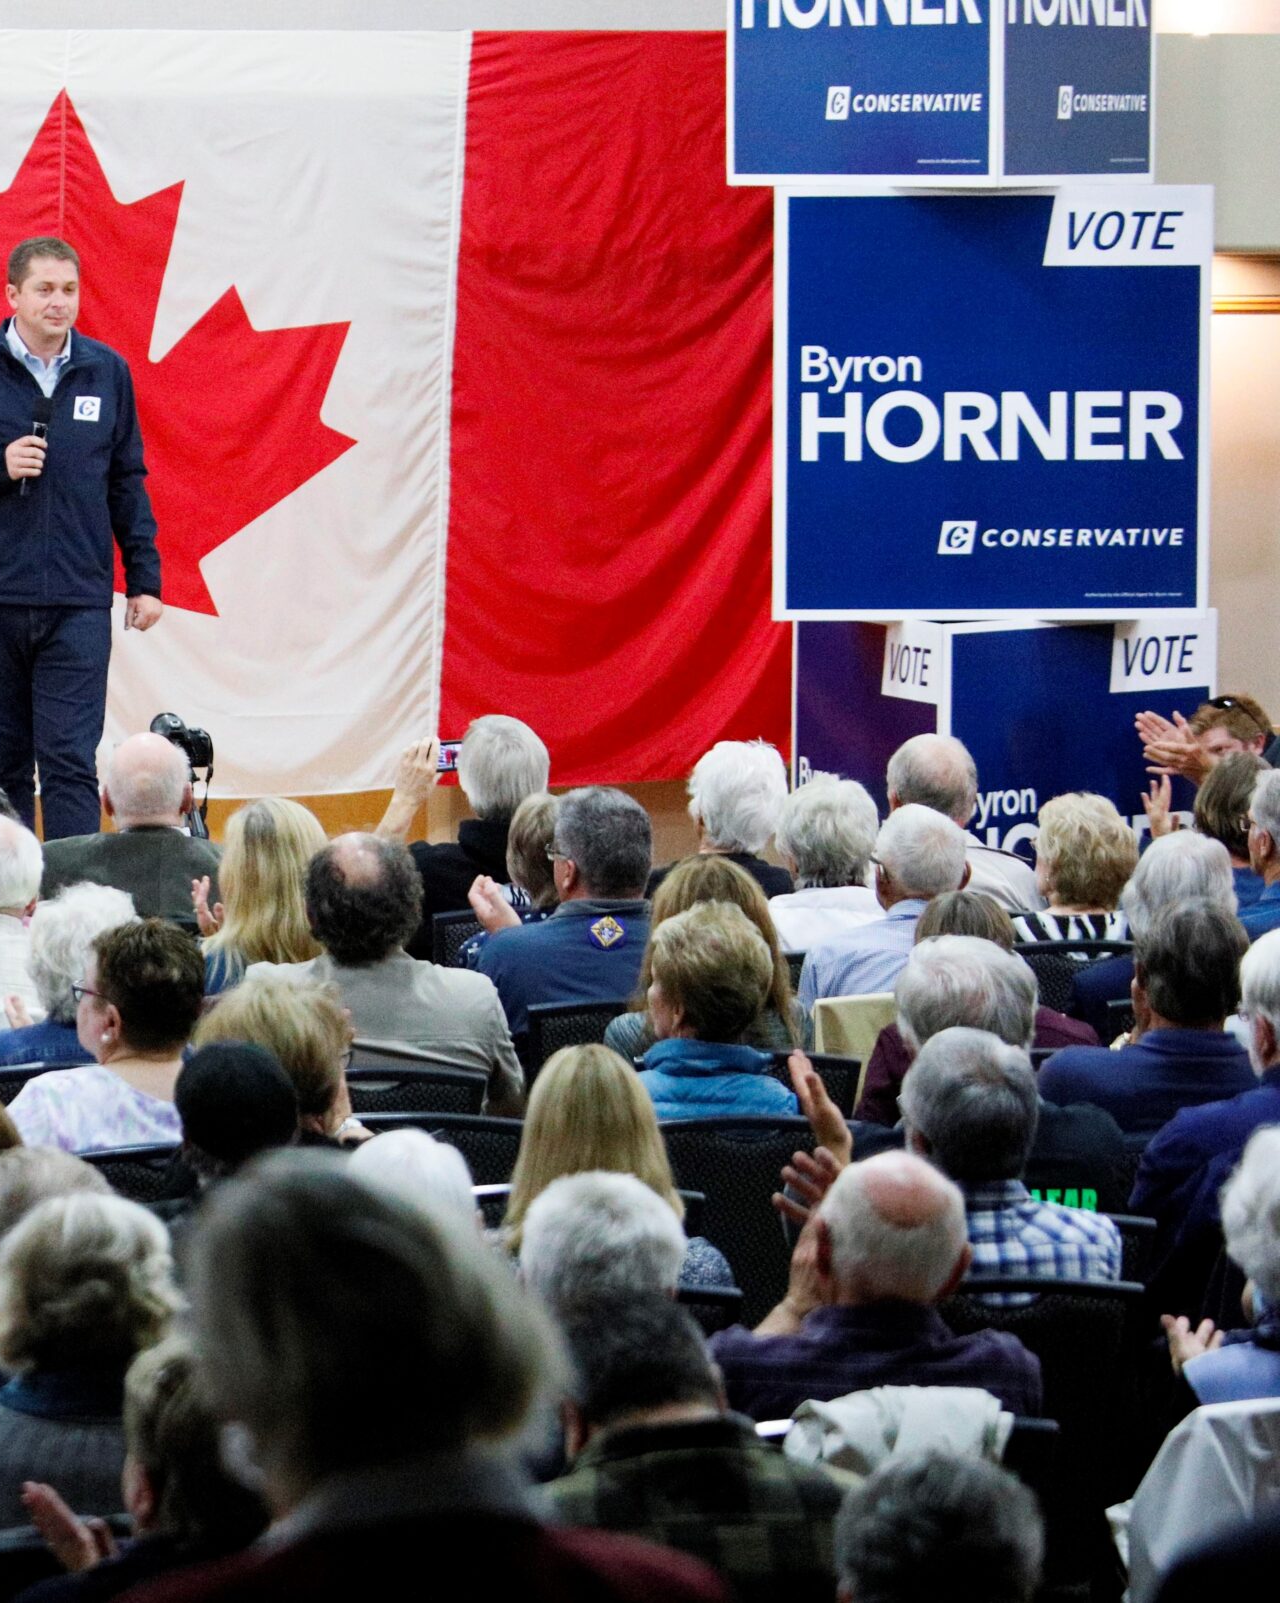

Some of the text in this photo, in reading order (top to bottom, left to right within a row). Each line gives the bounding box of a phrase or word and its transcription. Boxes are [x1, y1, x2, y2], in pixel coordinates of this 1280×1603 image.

[852, 93, 983, 113] CONSERVATIVE
[1073, 94, 1147, 112] CONSERVATIVE
[1068, 210, 1184, 250] VOTE
[800, 345, 922, 393] Byron
[800, 389, 1184, 463] HORNER
[982, 528, 1184, 547] CONSERVATIVE
[890, 642, 932, 687] VOTE
[1123, 633, 1198, 677] VOTE
[973, 787, 1037, 830] yron
